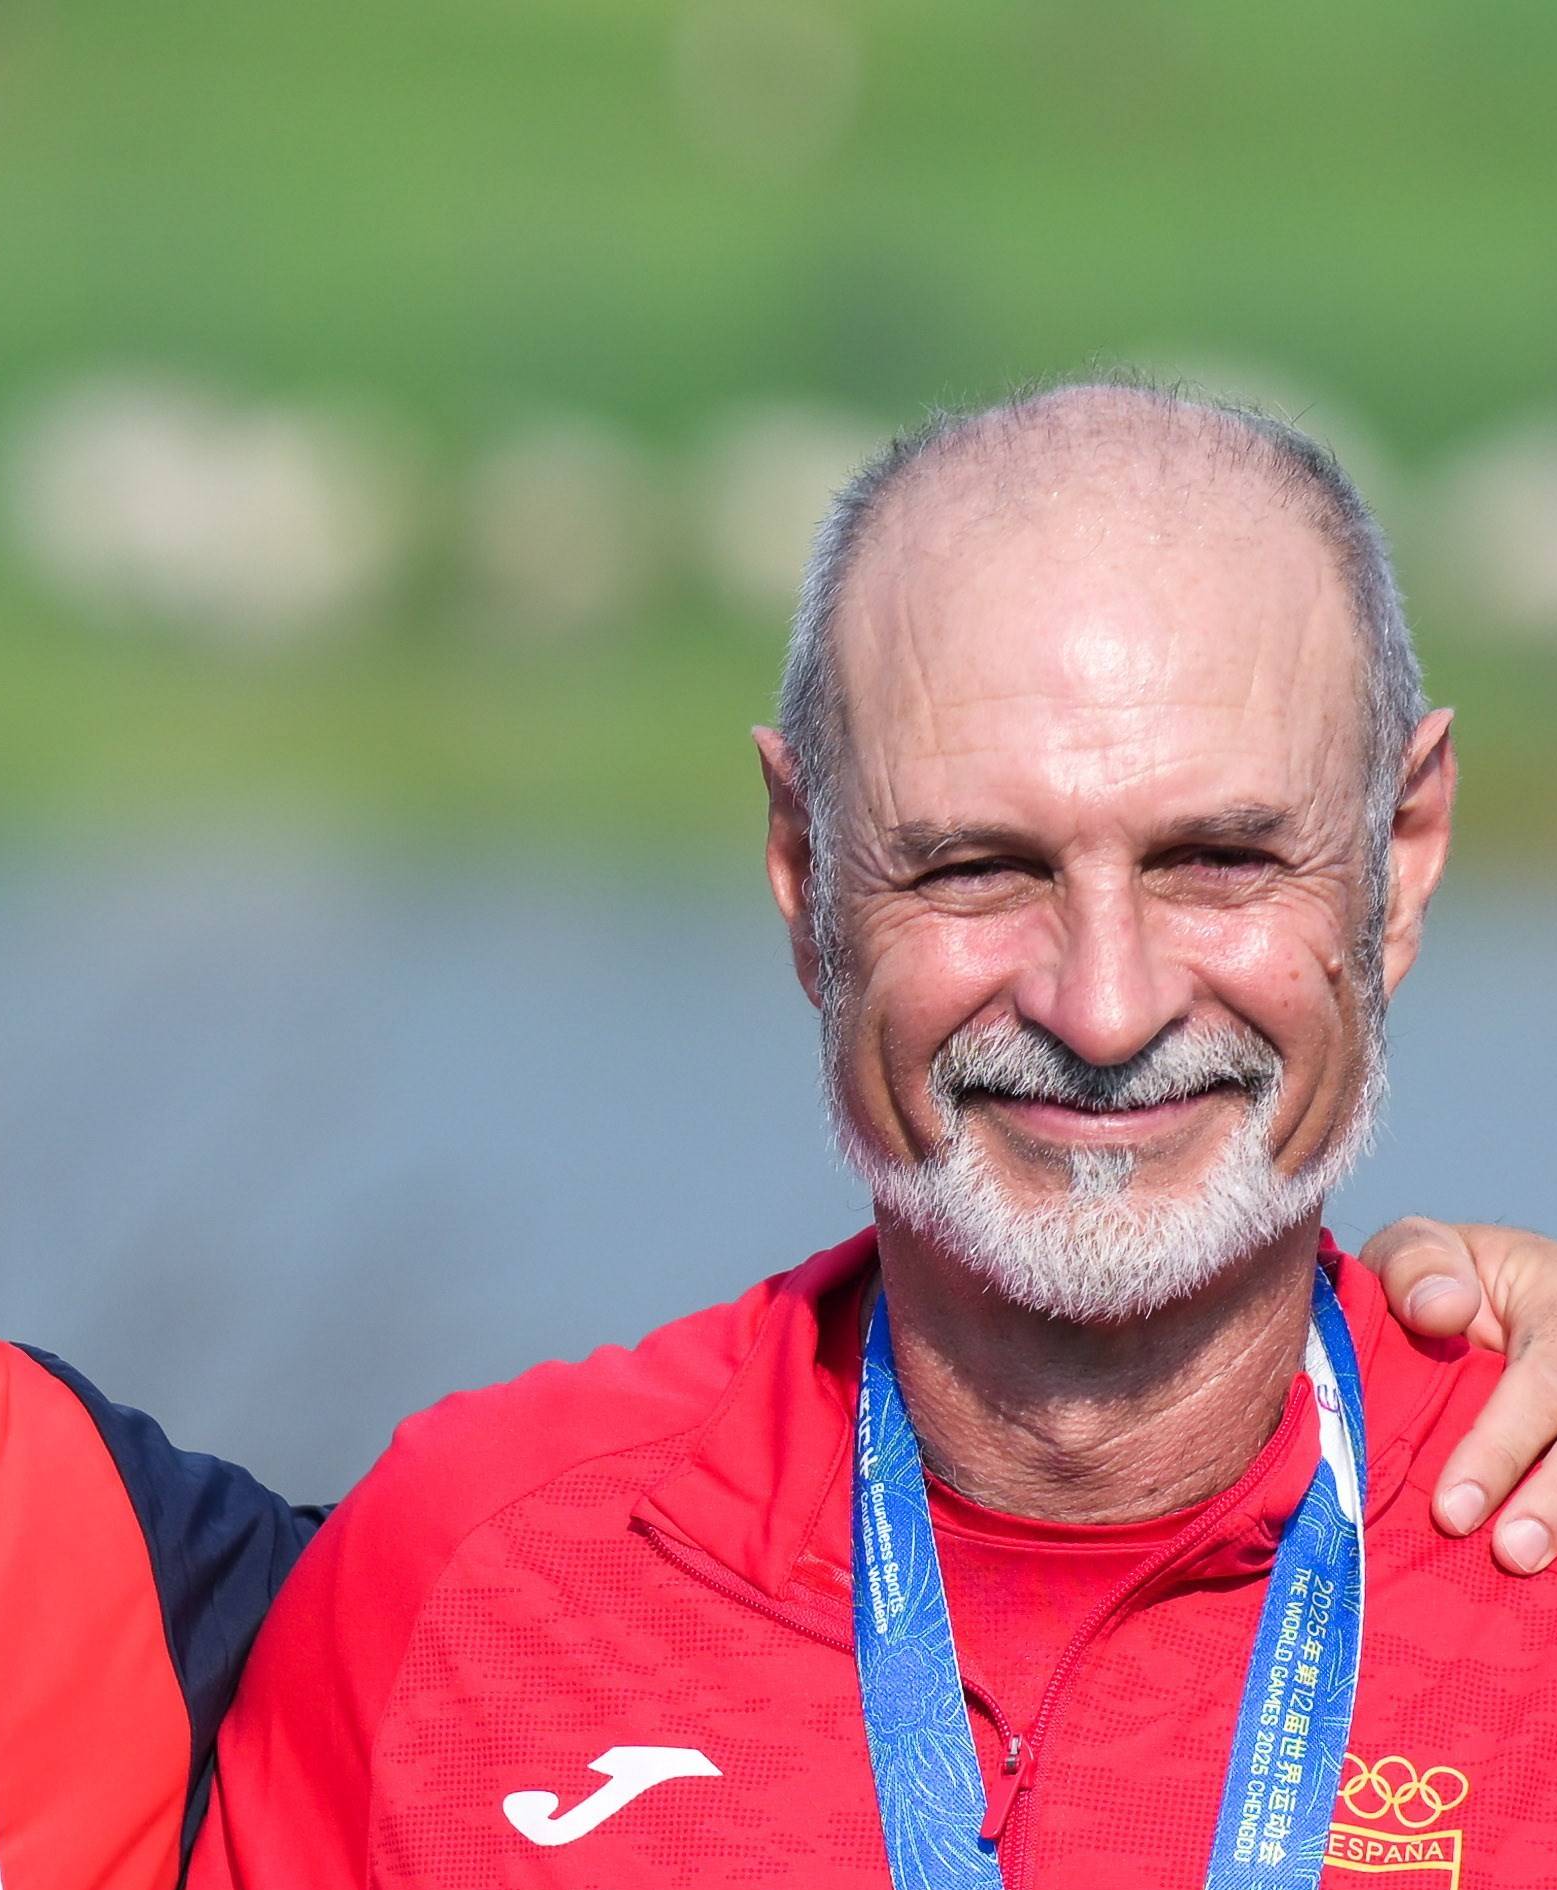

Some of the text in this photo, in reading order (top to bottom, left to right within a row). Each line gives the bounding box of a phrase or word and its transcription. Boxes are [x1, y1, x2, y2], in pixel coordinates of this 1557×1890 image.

[870, 1482, 892, 1561] Boundless
[866, 1565, 889, 1635] Wonders
[1233, 1567, 1312, 1863] THE WORLD GAMES 2025 CHENGDU
[1257, 1572, 1335, 1868] 2025年第12届世界运动会
[1329, 1834, 1444, 1864] ESPAÑA
